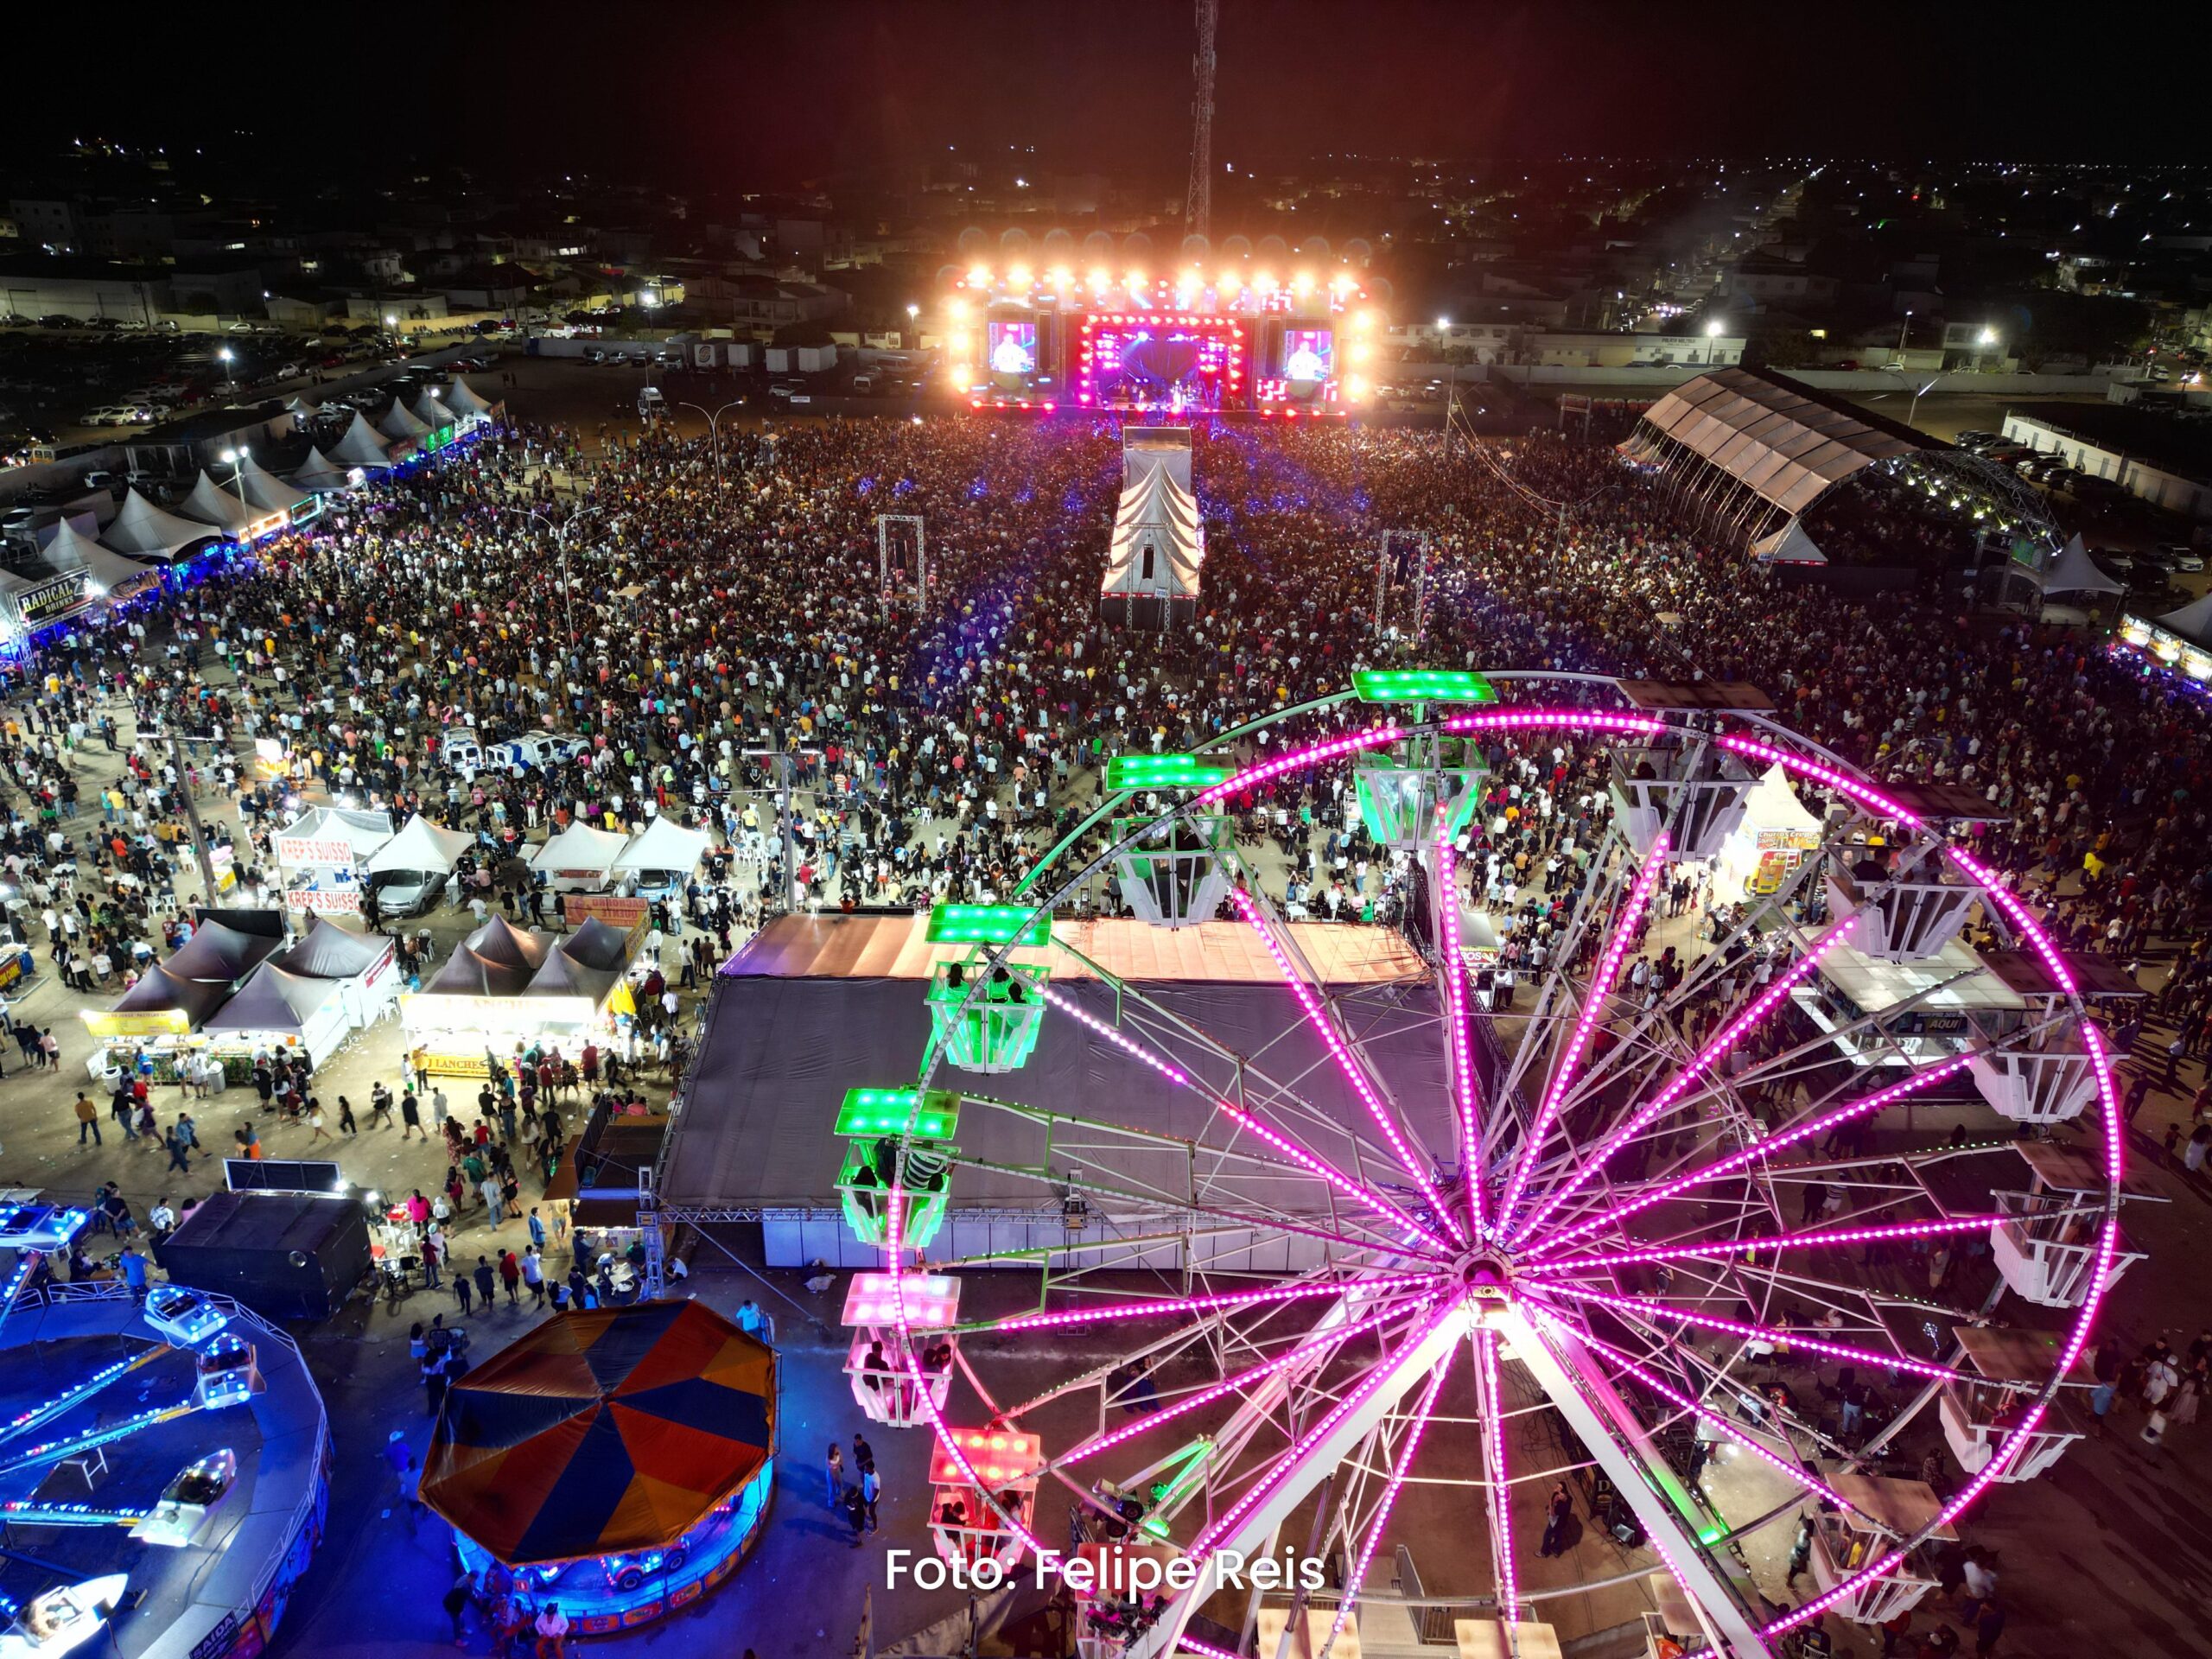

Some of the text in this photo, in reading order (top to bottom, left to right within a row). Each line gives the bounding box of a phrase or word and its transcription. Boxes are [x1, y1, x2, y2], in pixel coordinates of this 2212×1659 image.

[21, 582, 73, 613] RADICAL
[45, 595, 74, 613] DRINKS
[281, 840, 351, 861] KREP'S SUISSO
[288, 891, 360, 911] KREP'S SUISSO
[1929, 1019, 1960, 1029] AQUI
[435, 1058, 486, 1070] LANCHES
